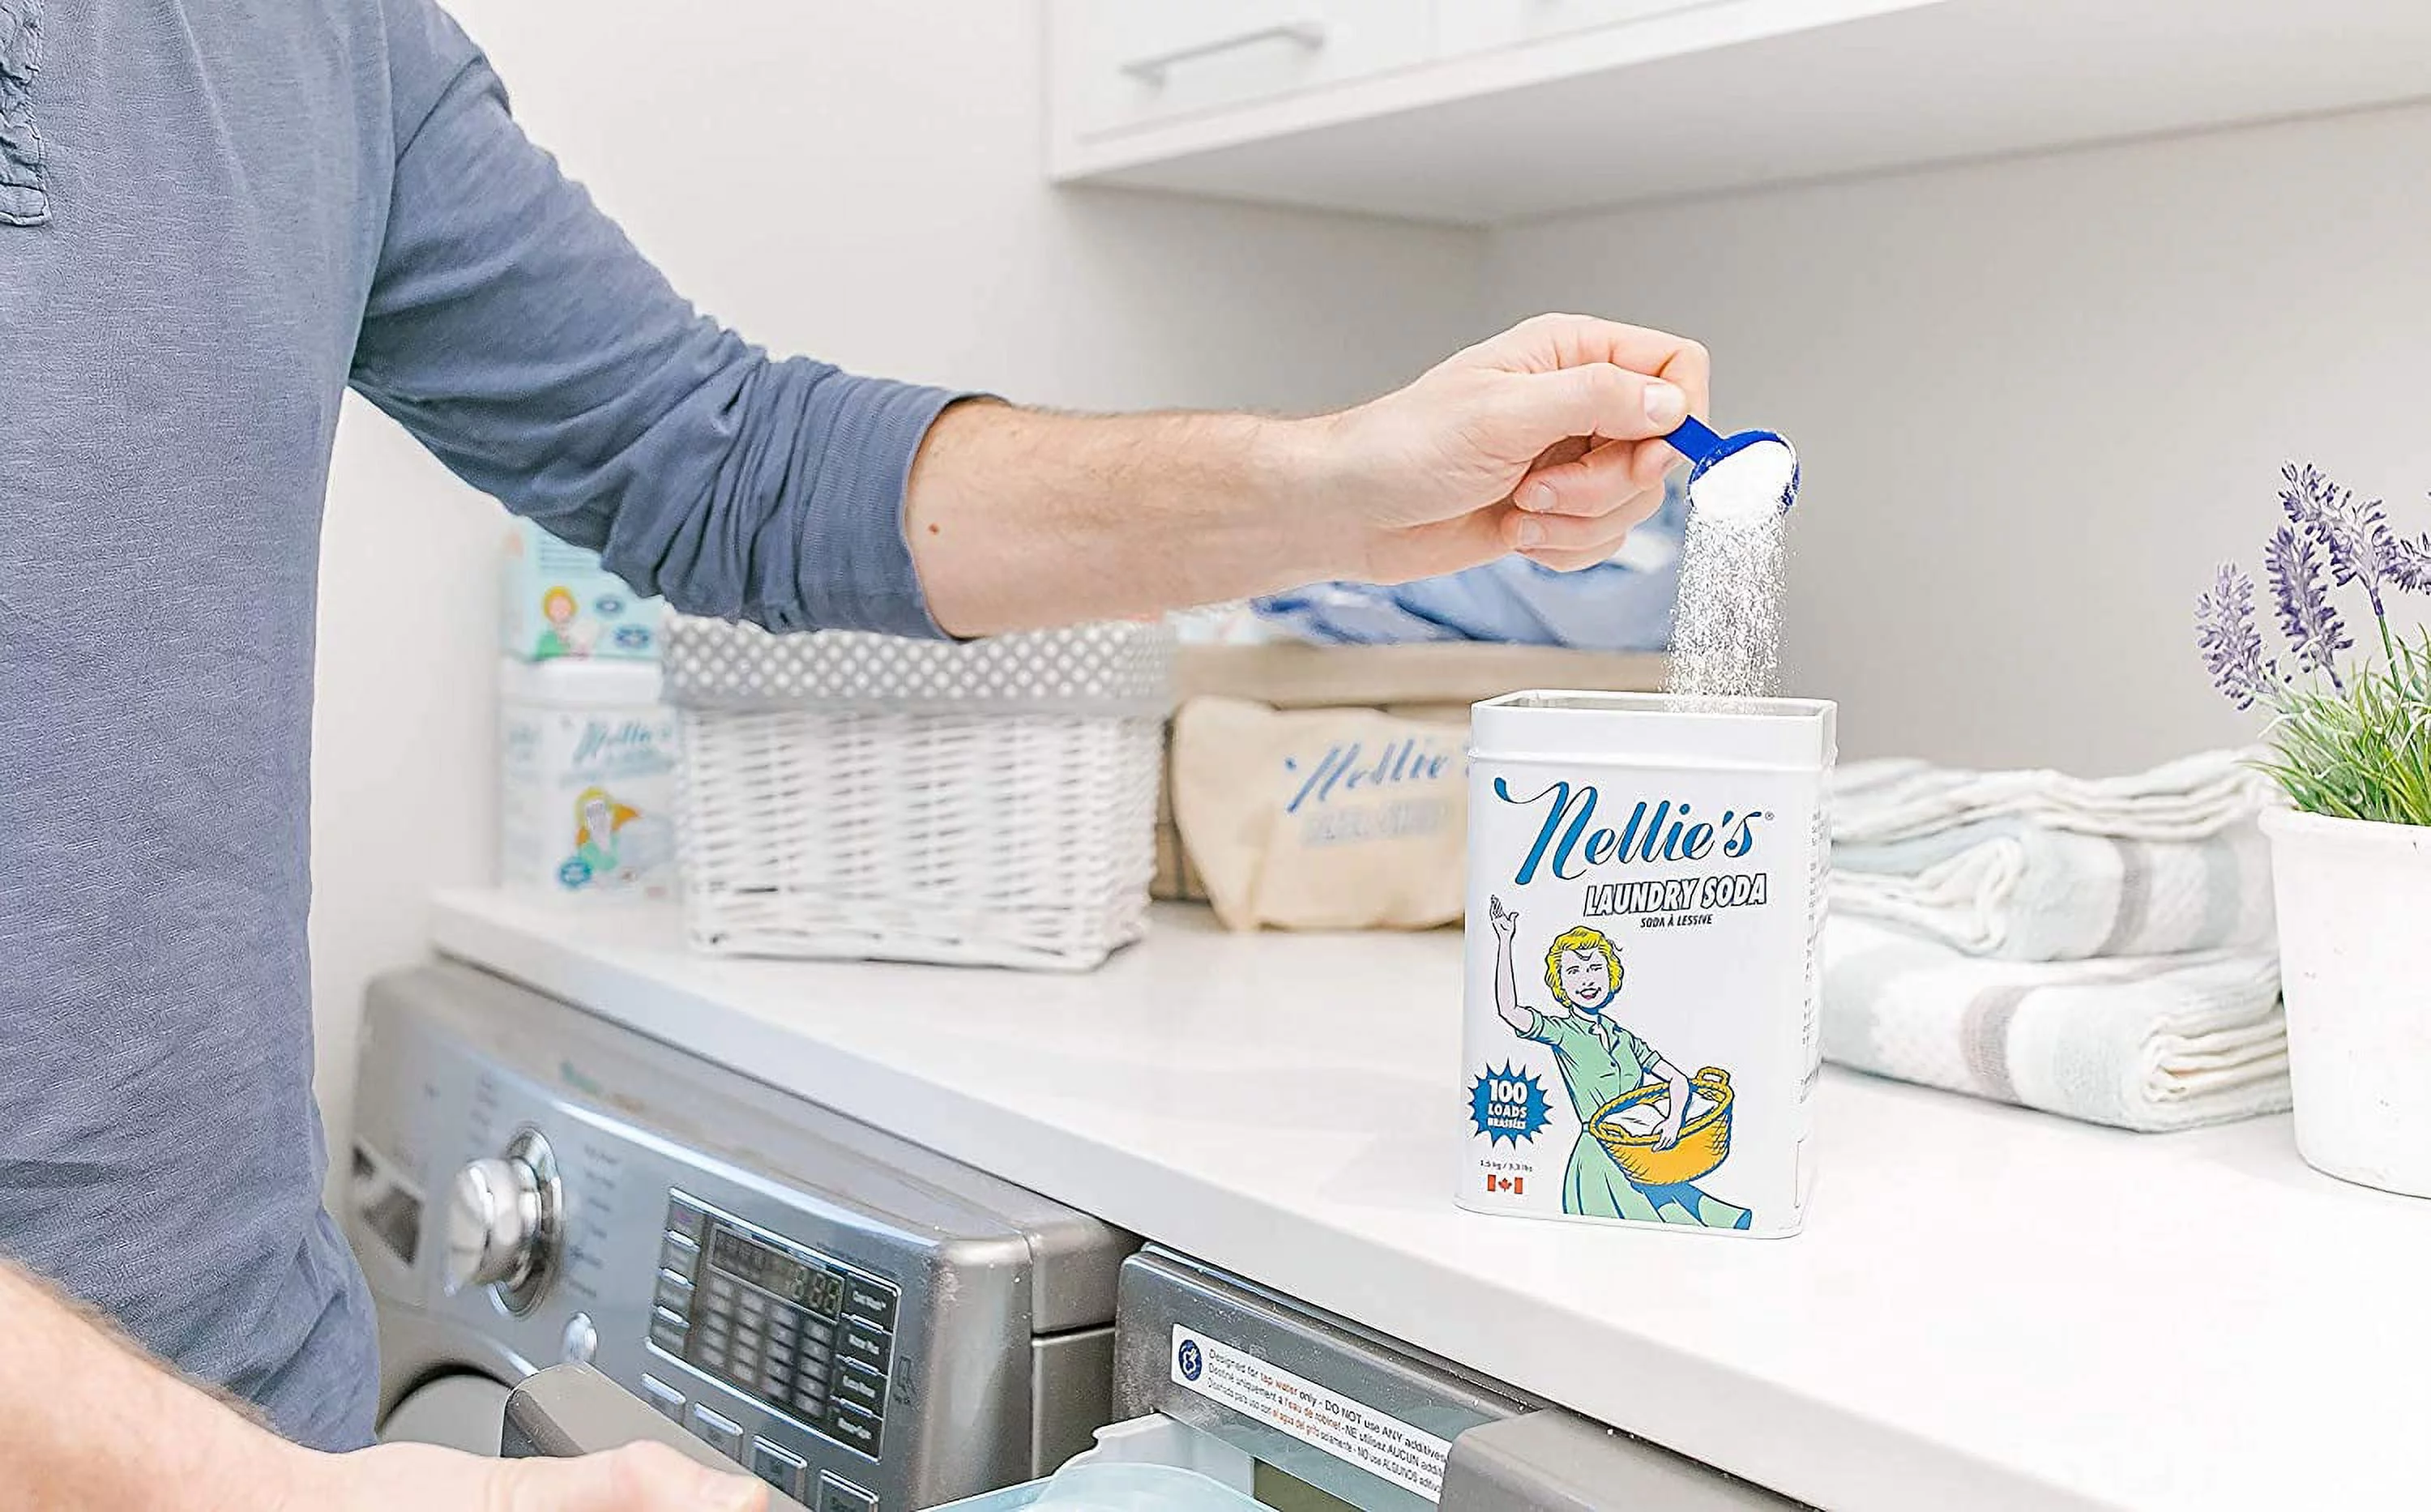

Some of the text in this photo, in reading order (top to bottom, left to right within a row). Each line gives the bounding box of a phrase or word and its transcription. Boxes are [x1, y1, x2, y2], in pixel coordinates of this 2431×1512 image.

[1284, 737, 1469, 813] Nellie
[1494, 776, 1762, 886] Nellie's
[1583, 873, 1768, 917] LAUNDRY SODA
[1640, 916, 1664, 928] SODA
[1677, 913, 1713, 926] LESSIVE
[1488, 1103, 1527, 1119] LOADS
[1489, 1078, 1528, 1104] 100
[1247, 1365, 1258, 1378] for
[1260, 1372, 1274, 1386] tap
[1275, 1380, 1298, 1396] water
[1299, 1390, 1318, 1407] only
[1324, 1399, 1340, 1416] DO
[1341, 1407, 1361, 1424] NOT
[1364, 1420, 1380, 1434] use
[1382, 1426, 1403, 1443] ANY
[1344, 1424, 1358, 1440] NE
[1386, 1444, 1419, 1467] AUCUN
[1357, 1446, 1369, 1461] NO
